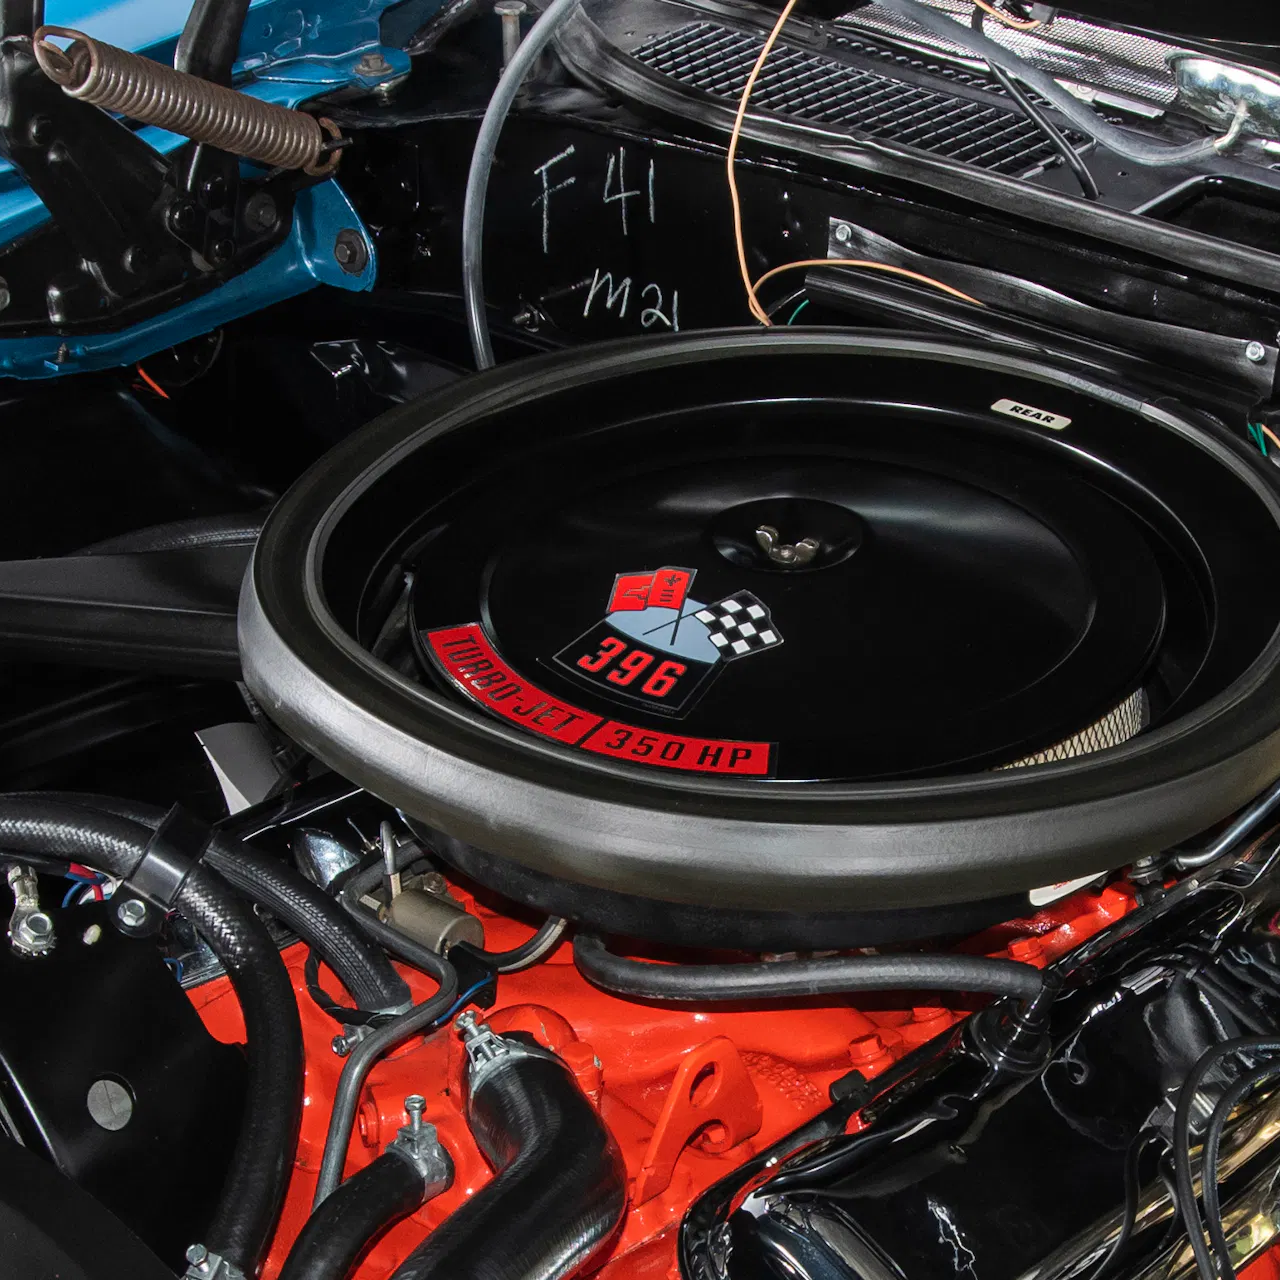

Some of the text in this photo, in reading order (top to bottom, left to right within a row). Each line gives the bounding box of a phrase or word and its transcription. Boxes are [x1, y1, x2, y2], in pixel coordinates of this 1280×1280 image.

[1009, 405, 1056, 424] REAR
[576, 636, 687, 697] 396
[440, 634, 754, 769] TURBO-JET 350 HP
